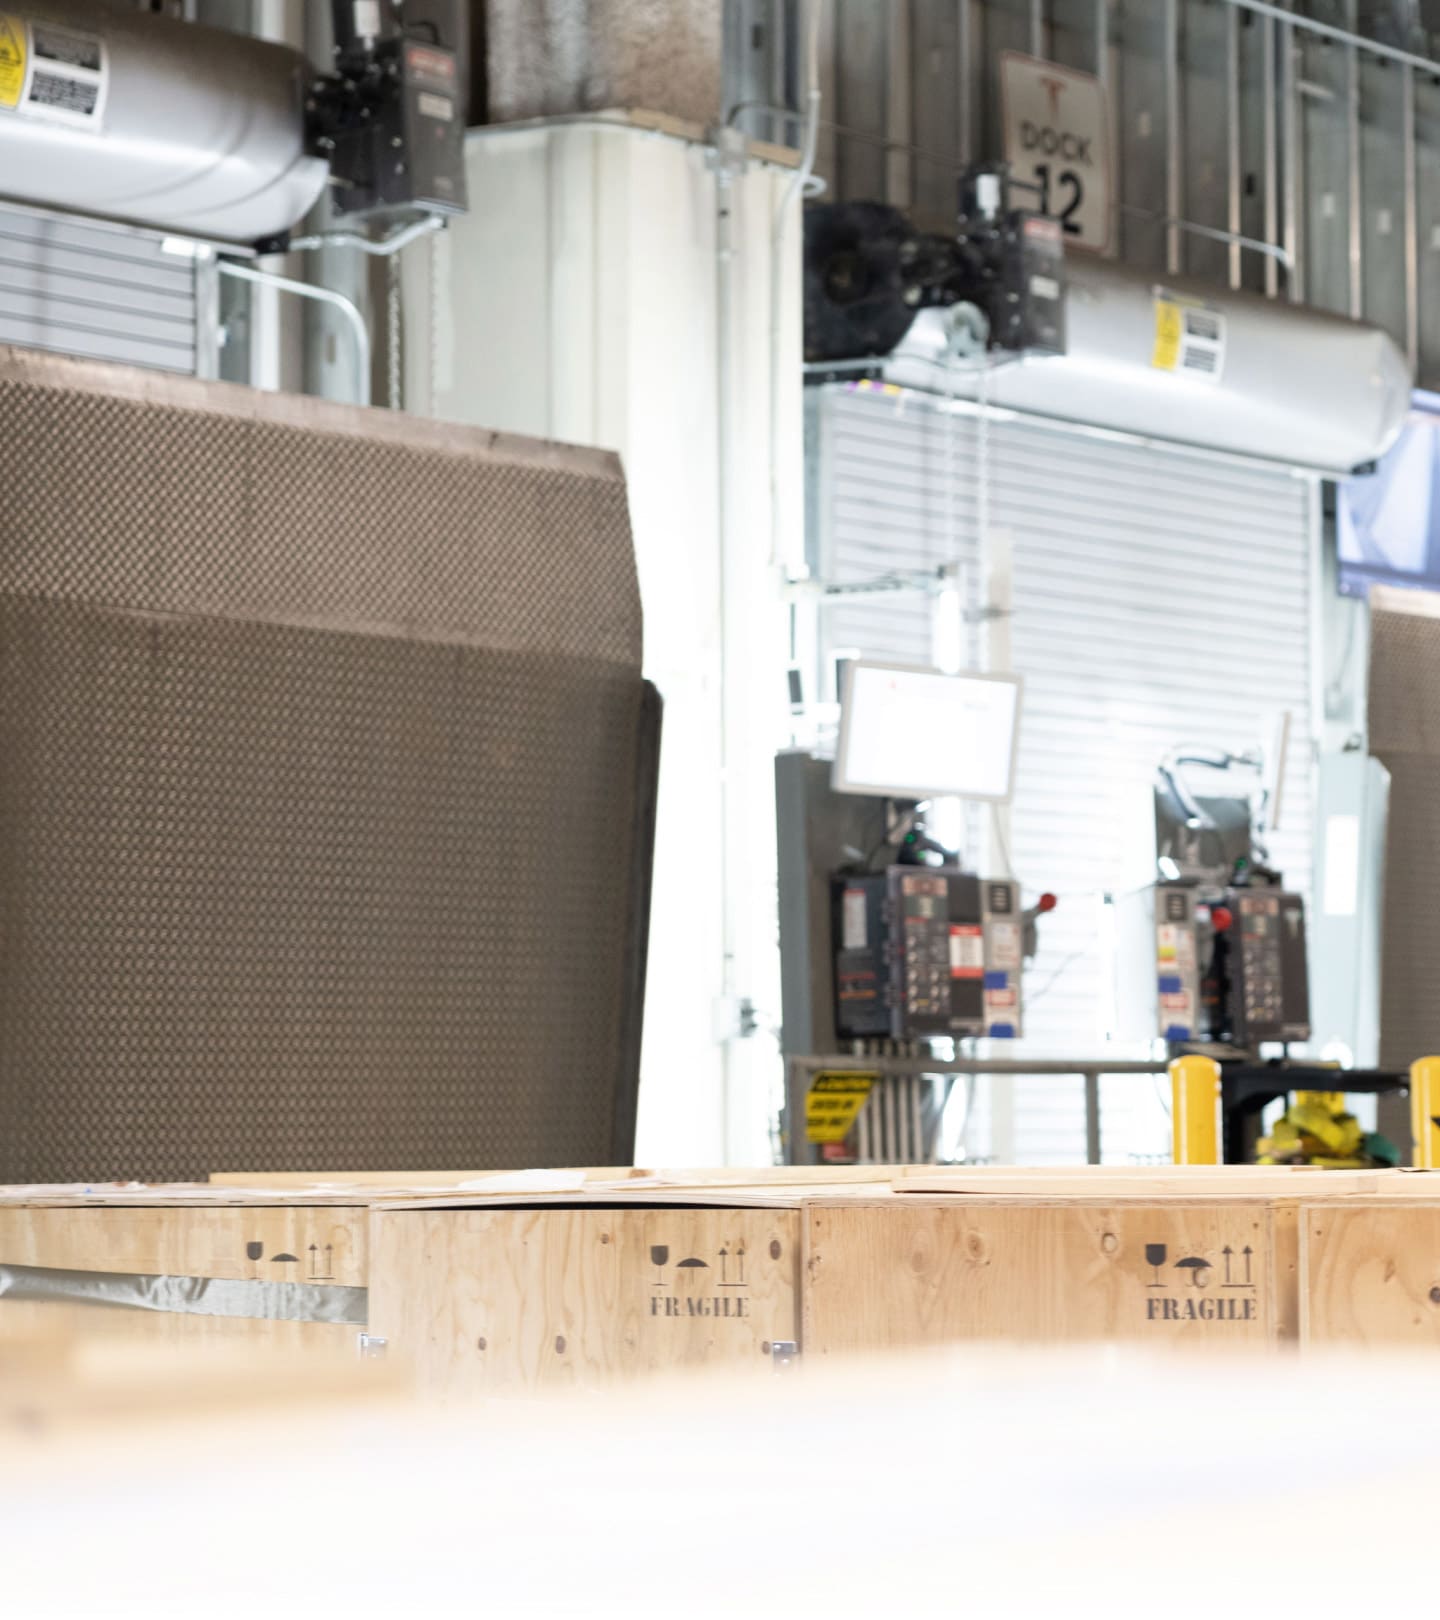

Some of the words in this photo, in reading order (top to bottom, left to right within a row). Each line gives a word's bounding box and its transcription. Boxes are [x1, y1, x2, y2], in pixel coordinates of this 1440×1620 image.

[1020, 118, 1094, 168] DOCK
[1034, 164, 1084, 237] 12
[651, 1296, 750, 1318] FRAGILE
[1146, 1297, 1258, 1321] FRAGILE
